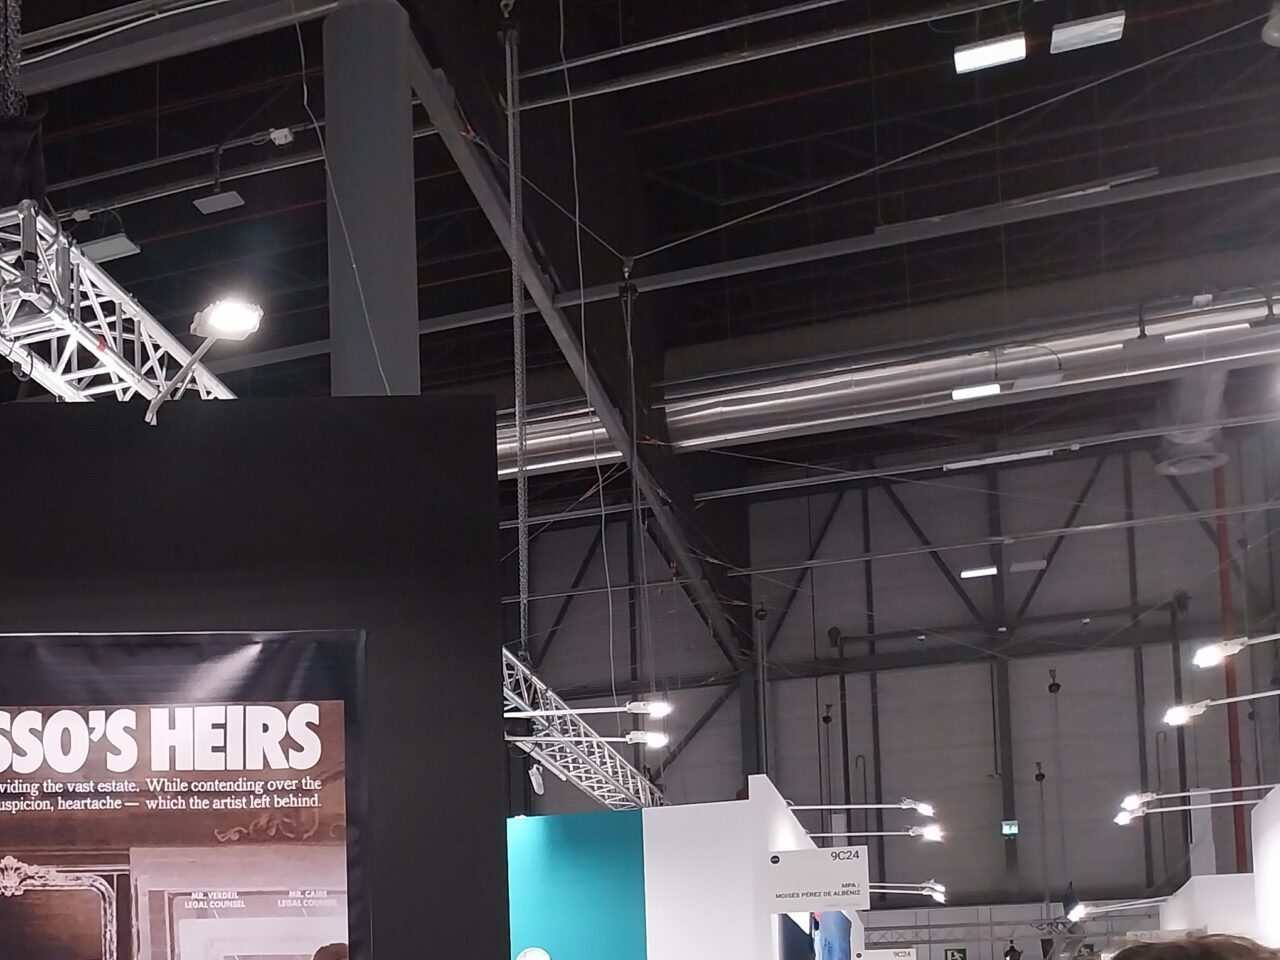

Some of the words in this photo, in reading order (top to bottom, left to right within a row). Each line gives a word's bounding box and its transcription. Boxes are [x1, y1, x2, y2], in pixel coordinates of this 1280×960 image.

[150, 703, 321, 771] HEIRS
[43, 780, 63, 793] the
[67, 781, 94, 792] vast
[98, 780, 139, 792] estate.
[146, 778, 188, 792] While
[191, 778, 263, 793] contending
[267, 780, 298, 791] over
[302, 777, 321, 790] the
[58, 797, 121, 811] heartache
[146, 796, 185, 809] which
[189, 796, 208, 808] the
[213, 796, 246, 808] artist
[250, 795, 271, 808] left
[274, 795, 321, 807] behind.
[831, 850, 859, 861] 9C24
[210, 900, 245, 908] COUNSEL
